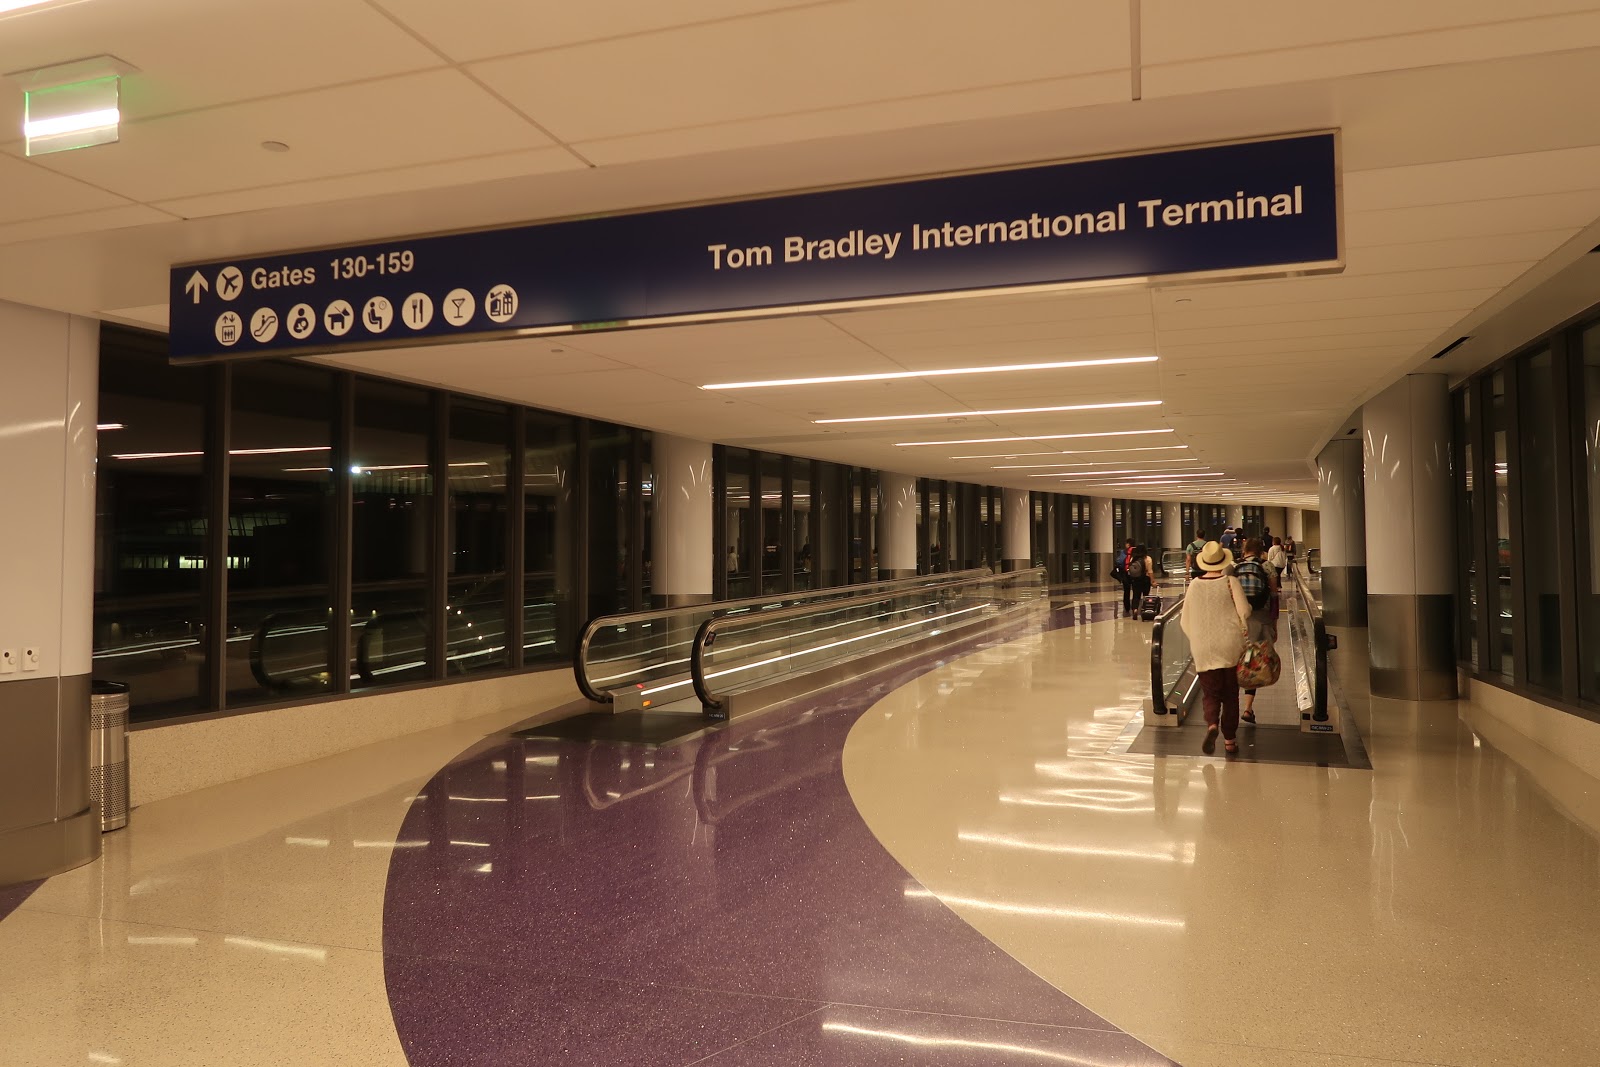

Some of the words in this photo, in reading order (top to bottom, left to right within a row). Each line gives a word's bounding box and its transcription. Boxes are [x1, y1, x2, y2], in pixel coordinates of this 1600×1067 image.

[707, 243, 772, 270] Tom
[784, 229, 902, 264] Bradley
[913, 202, 1126, 251] International
[1137, 185, 1303, 228] Terminal
[251, 265, 317, 290] Gates
[330, 250, 415, 280] 130-159
